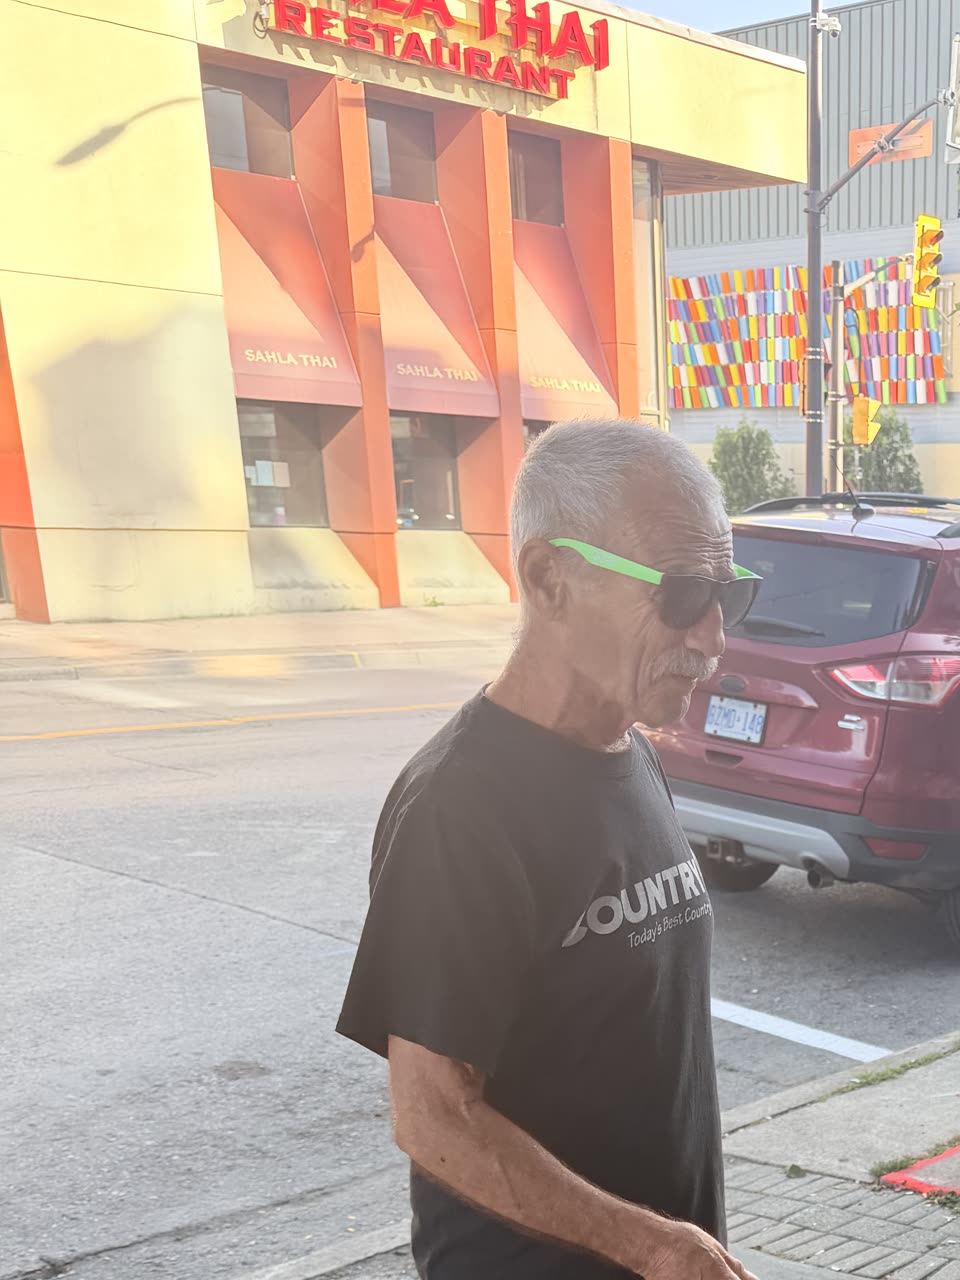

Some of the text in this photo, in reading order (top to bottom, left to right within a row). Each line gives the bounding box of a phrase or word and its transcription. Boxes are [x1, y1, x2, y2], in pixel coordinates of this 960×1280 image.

[274, 0, 576, 99] RESTAURANT
[479, 0, 609, 71] THAI
[244, 349, 338, 369] SAHLA THAI
[396, 363, 479, 382] SAHLA THAI
[529, 376, 602, 393] SAHLA THAI
[628, 903, 713, 948] Today's Best Country
